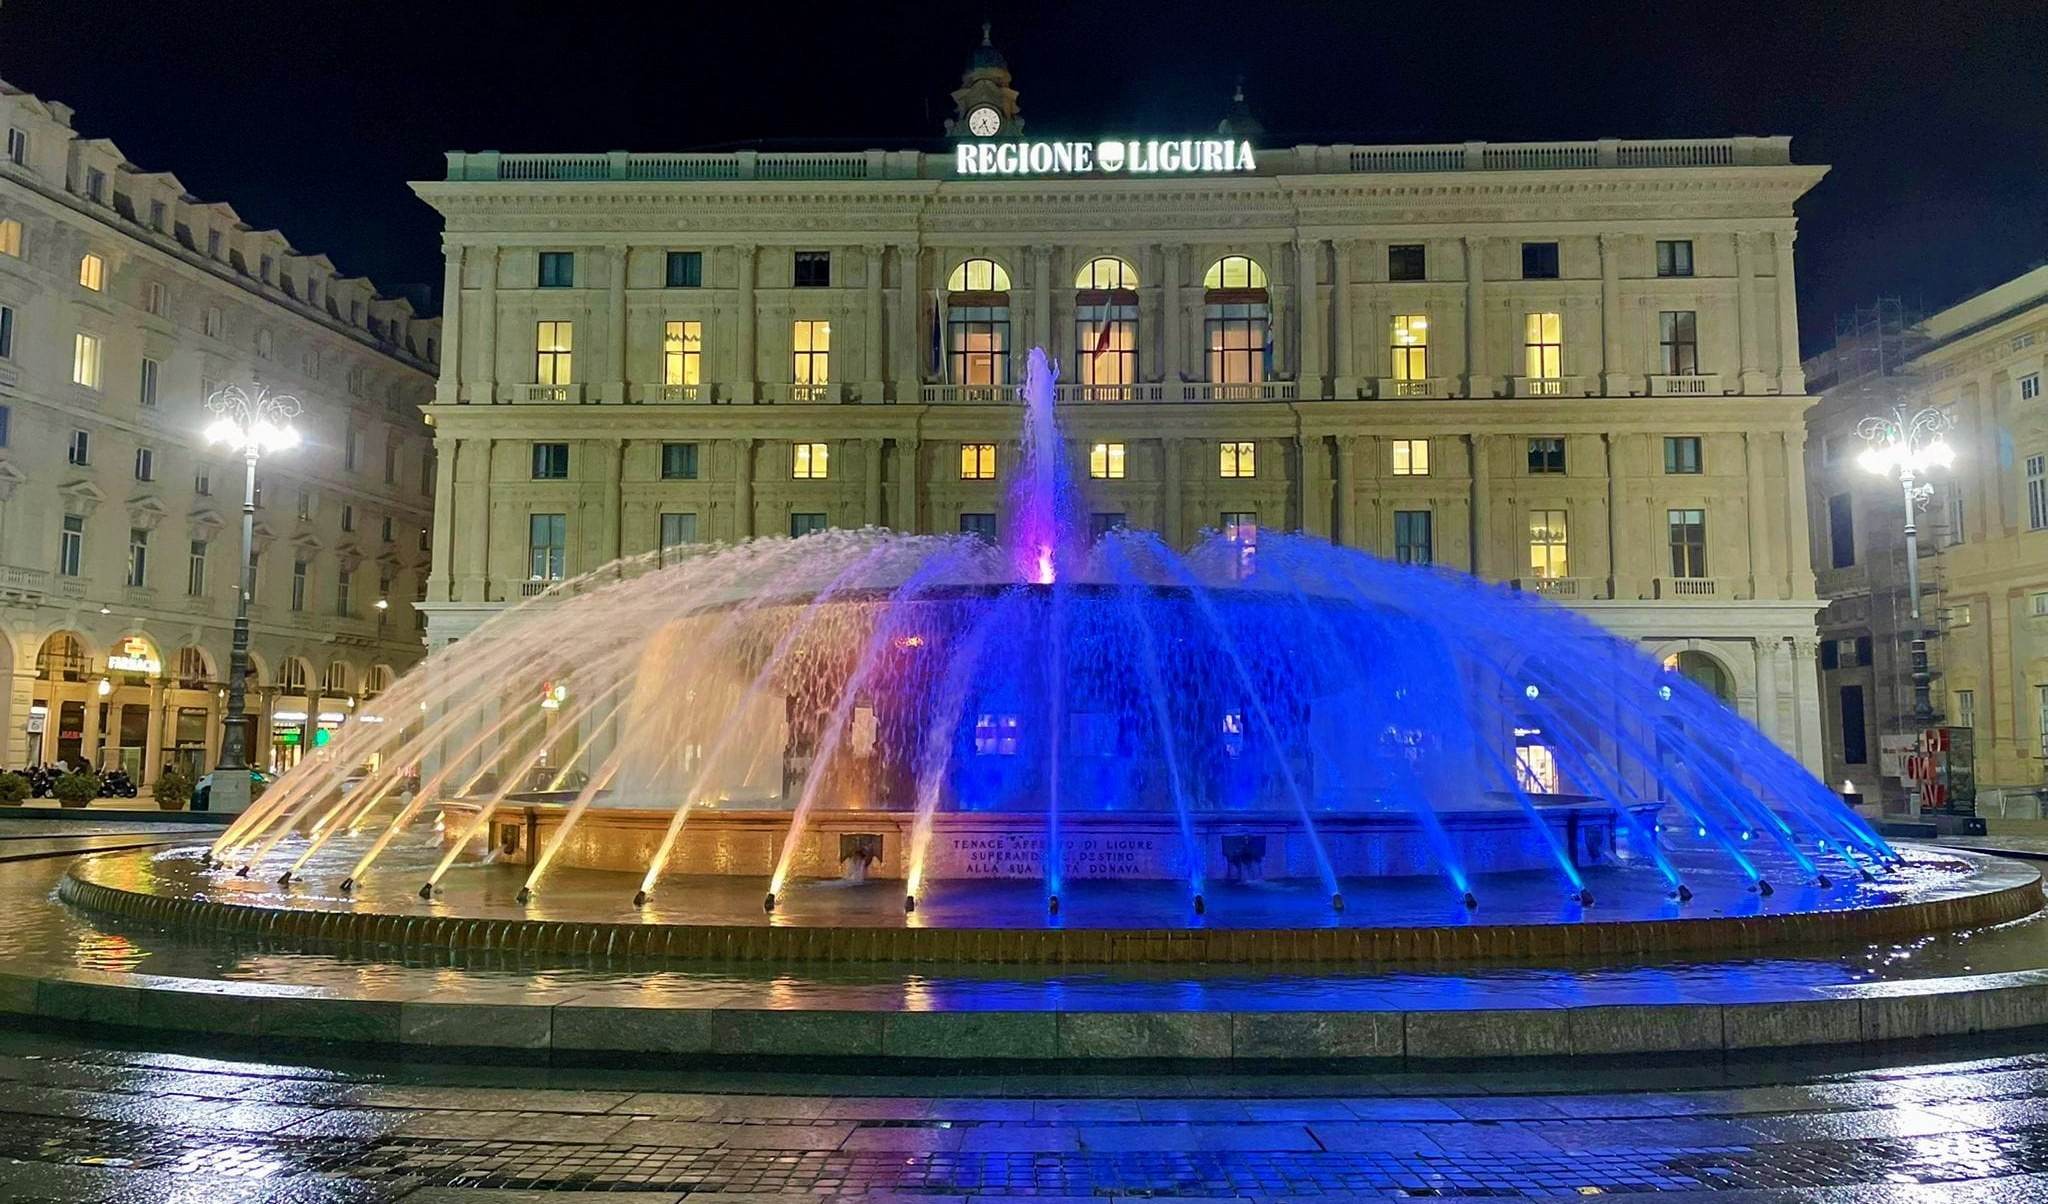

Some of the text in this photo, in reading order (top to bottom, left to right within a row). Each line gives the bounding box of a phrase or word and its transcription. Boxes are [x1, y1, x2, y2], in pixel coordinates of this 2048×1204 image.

[956, 139, 1257, 174] REGIONE LIGURIA
[953, 840, 1004, 850] TENACE
[1084, 840, 1097, 850] DI
[1106, 840, 1153, 850] LIGURE
[1080, 852, 1135, 862] DESTINO
[966, 864, 999, 873] ALLA
[1008, 864, 1032, 874] SUA
[1089, 864, 1140, 874] DONAVA
